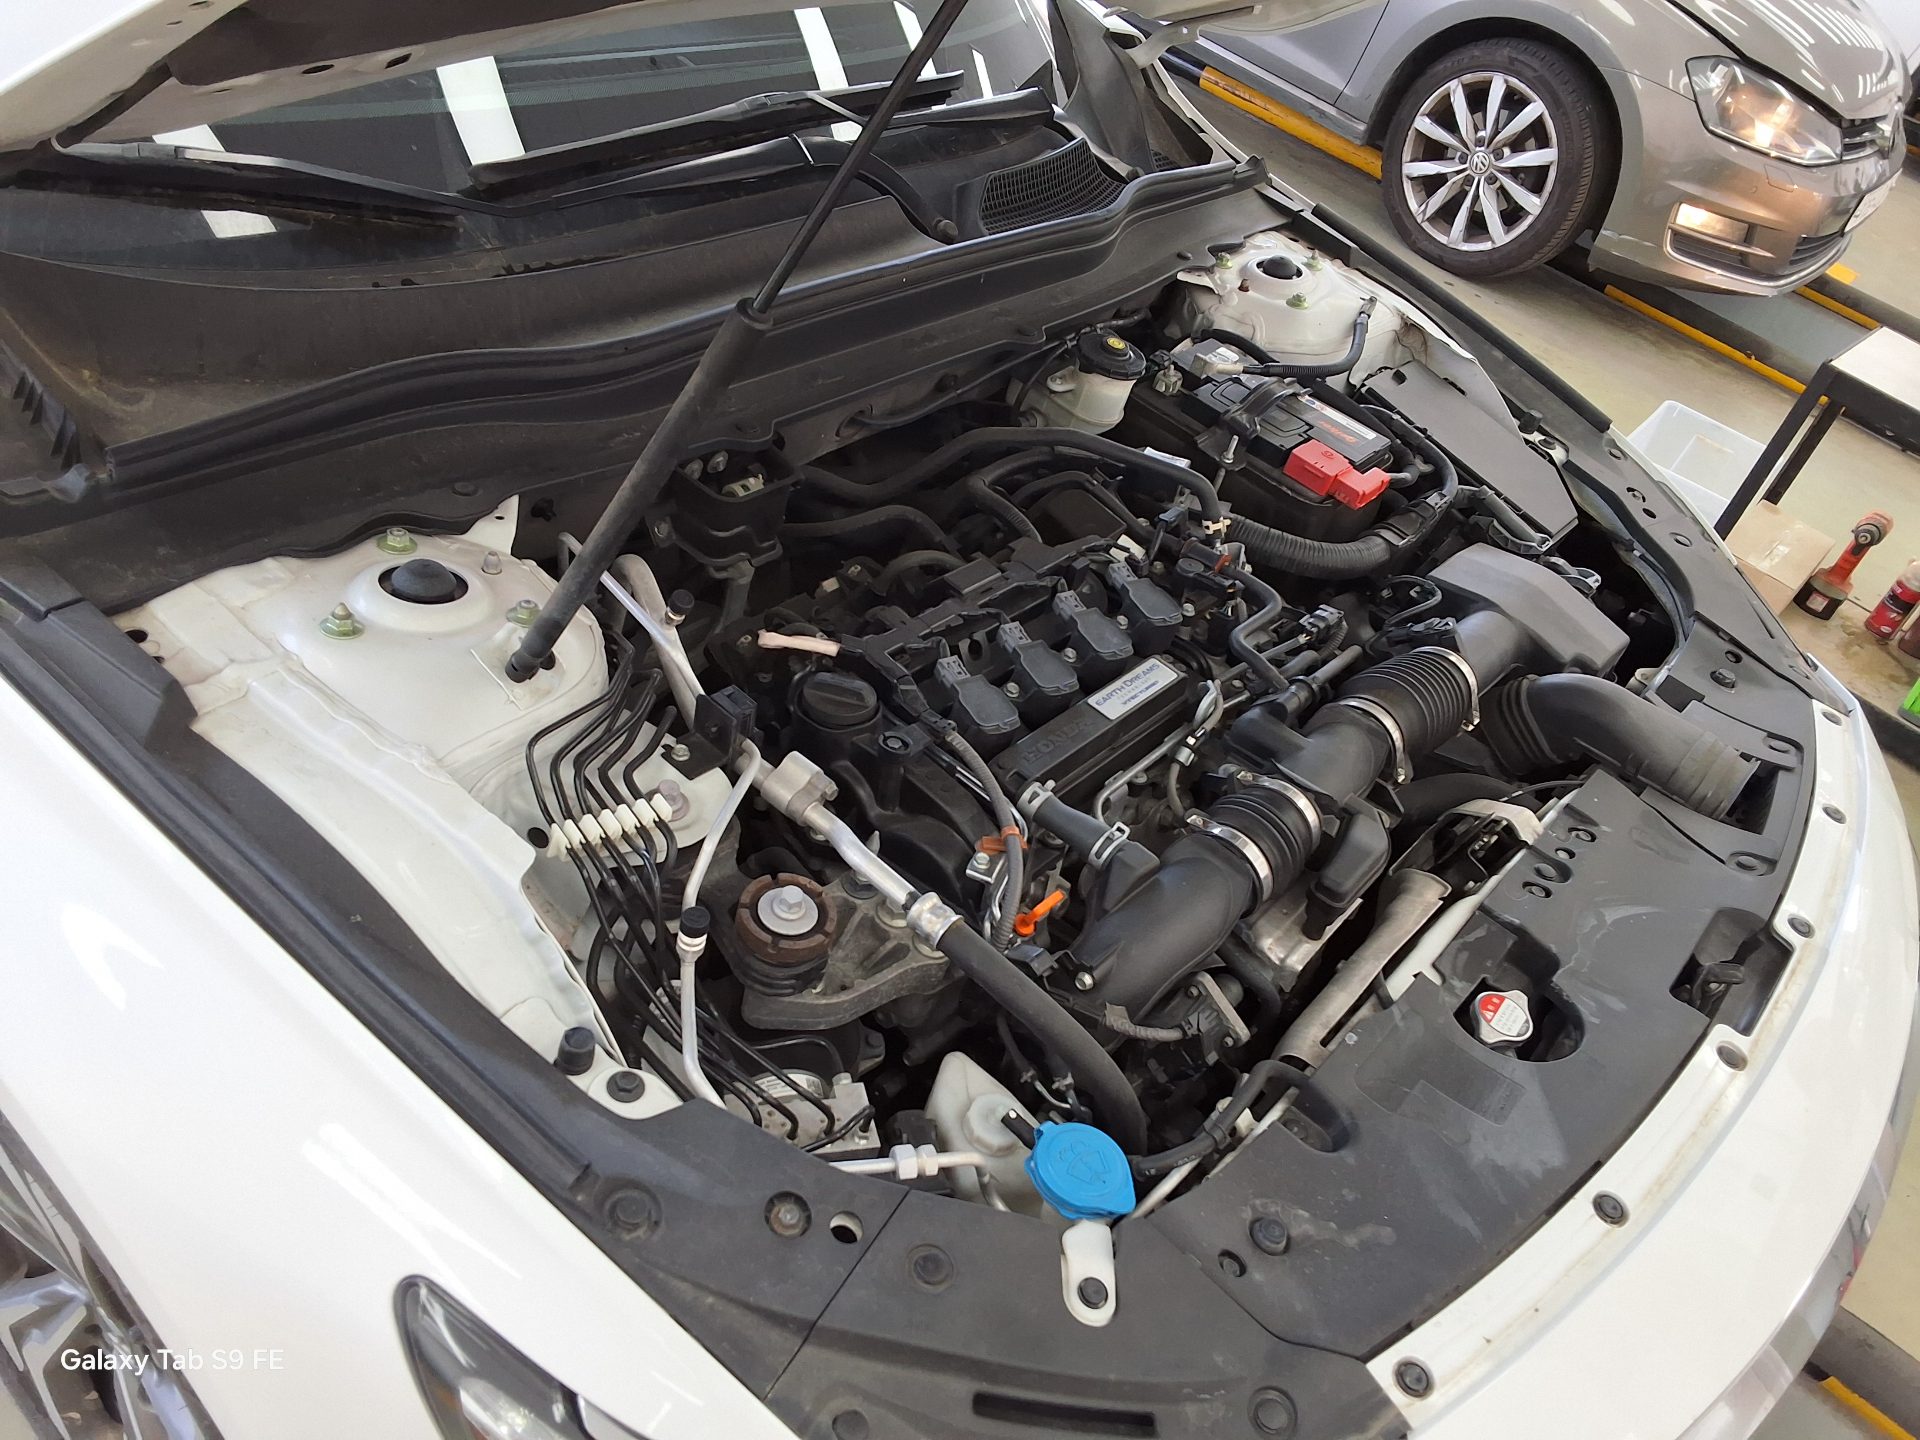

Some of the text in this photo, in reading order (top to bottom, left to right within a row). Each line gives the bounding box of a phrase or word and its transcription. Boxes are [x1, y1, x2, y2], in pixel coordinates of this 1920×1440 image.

[1095, 685, 1126, 706] EARTH
[1122, 663, 1160, 687] DREAMS
[1021, 718, 1096, 764] HONDA
